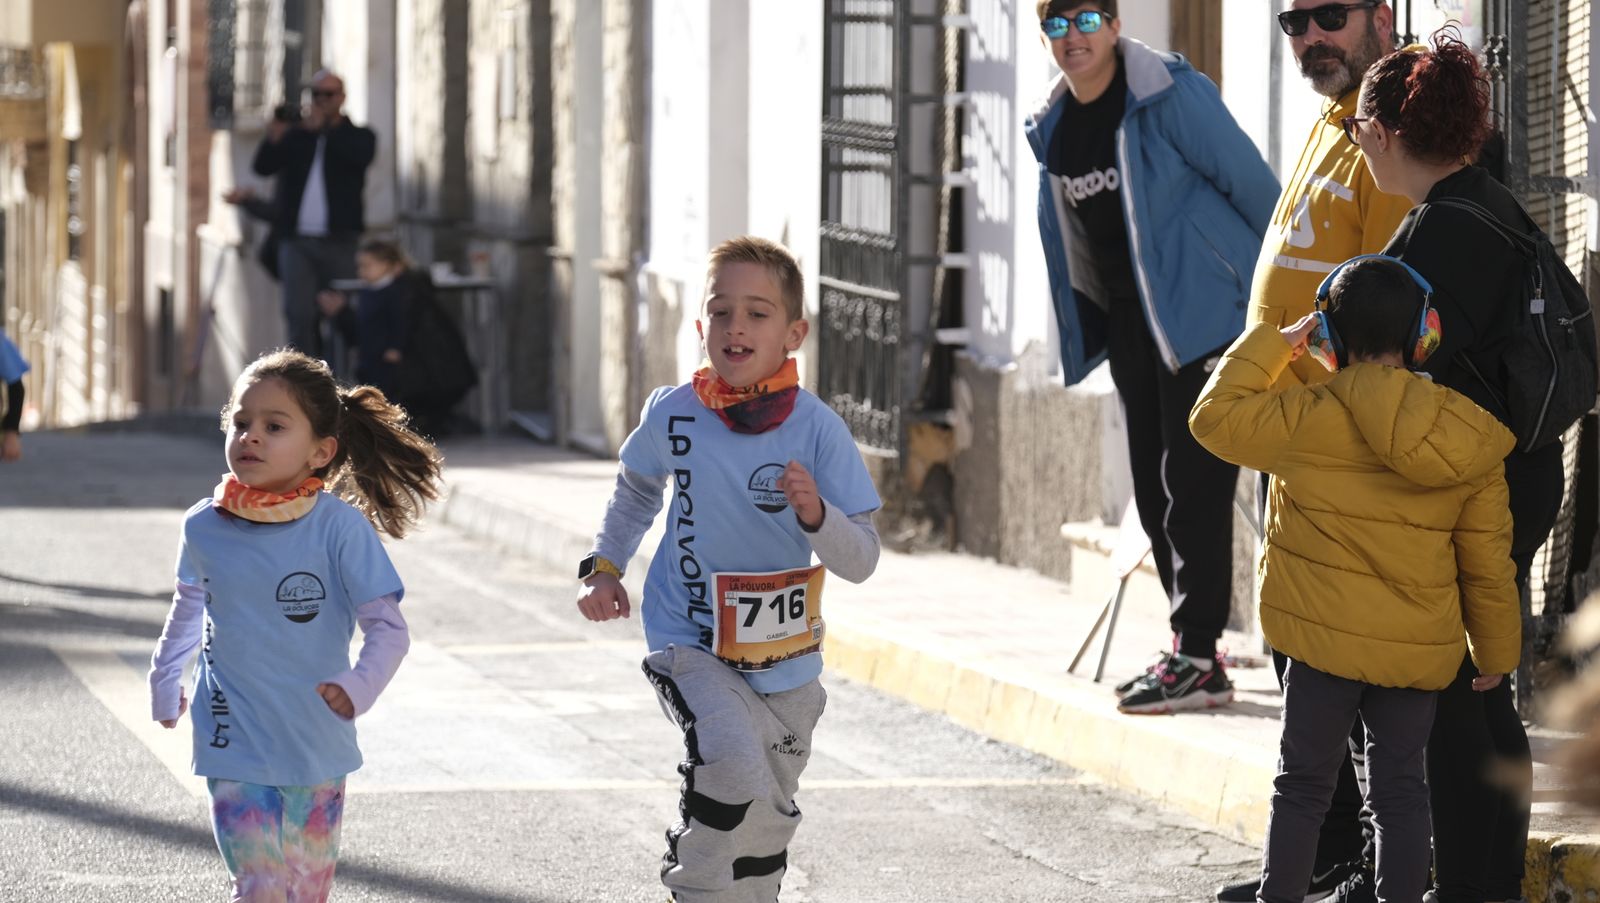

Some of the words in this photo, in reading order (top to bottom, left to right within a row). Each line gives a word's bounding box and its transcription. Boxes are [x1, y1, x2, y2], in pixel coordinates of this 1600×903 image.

[1060, 167, 1119, 208] Reebo
[668, 416, 695, 456] LA
[729, 583, 739, 591] LA
[738, 588, 804, 627] 716
[771, 742, 805, 757] KELME
